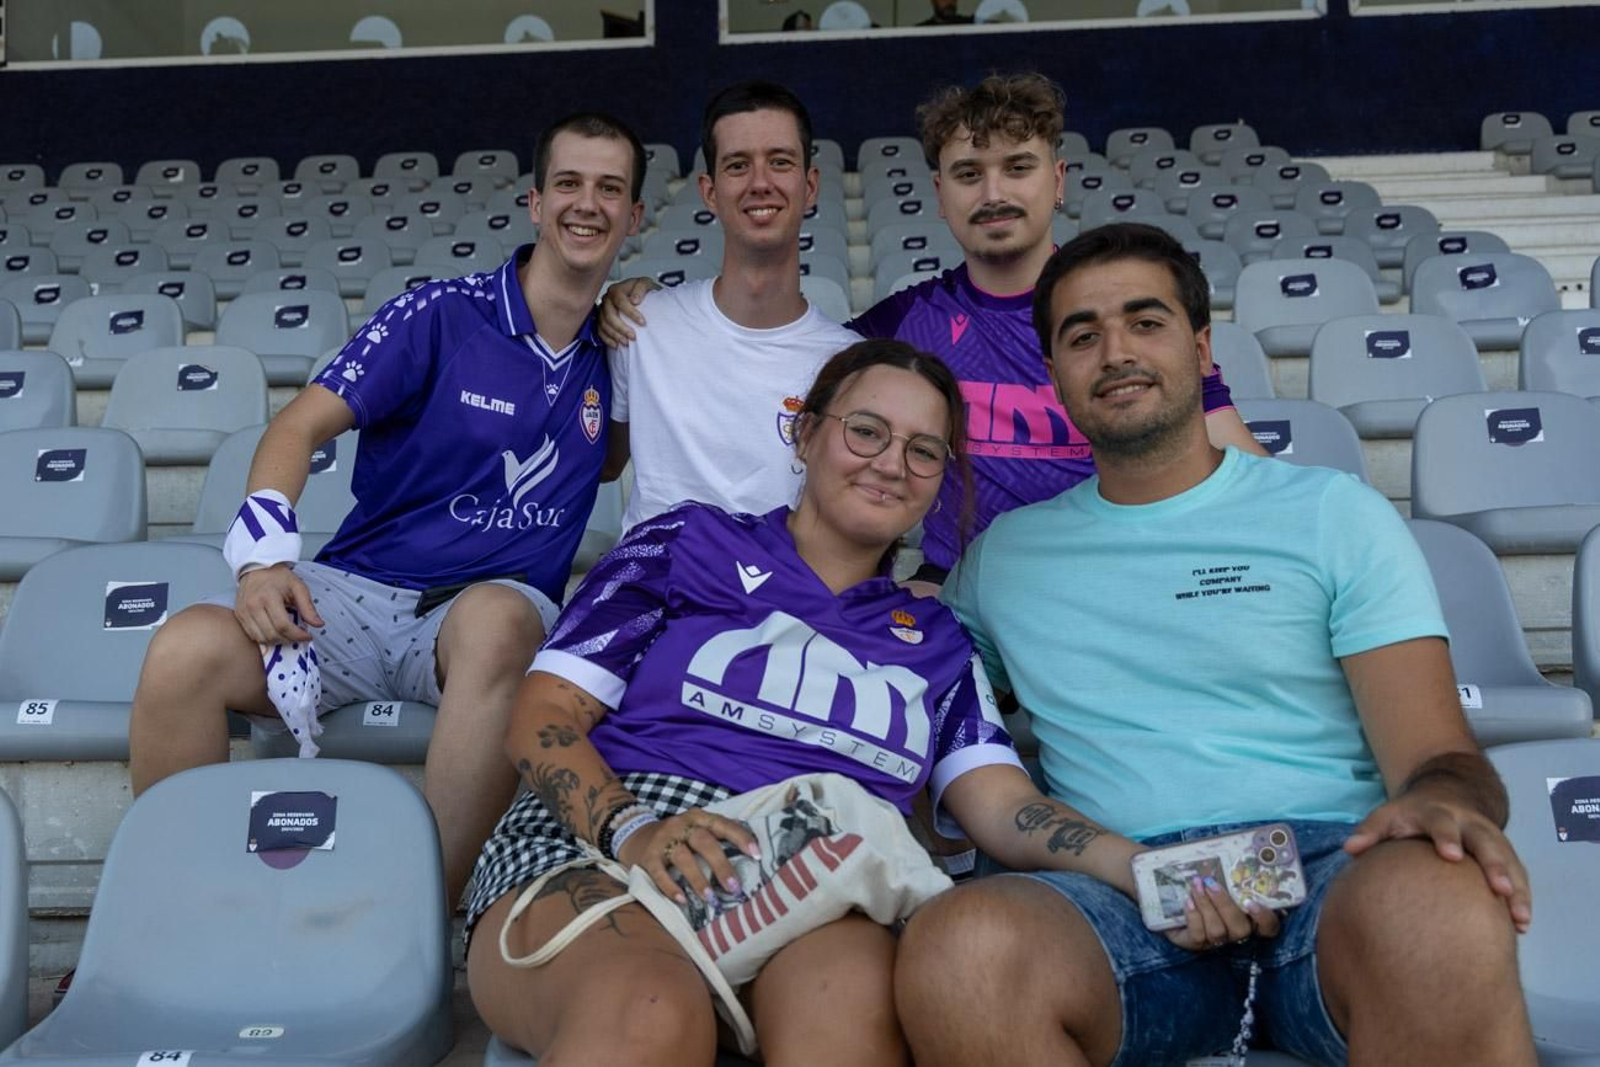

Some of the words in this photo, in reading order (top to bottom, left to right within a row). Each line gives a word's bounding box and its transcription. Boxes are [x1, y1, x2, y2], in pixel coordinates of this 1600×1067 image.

[460, 390, 515, 416] KELME
[972, 445, 1085, 457] SYSTEM
[1231, 564, 1250, 572] YOU
[1200, 575, 1242, 586] COMPANY
[1234, 584, 1271, 593] WAITING
[26, 702, 49, 715] 85
[372, 704, 394, 716] 84
[1571, 804, 1600, 814] ABON
[267, 817, 319, 827] ABONADOS
[149, 1051, 182, 1062] 84
